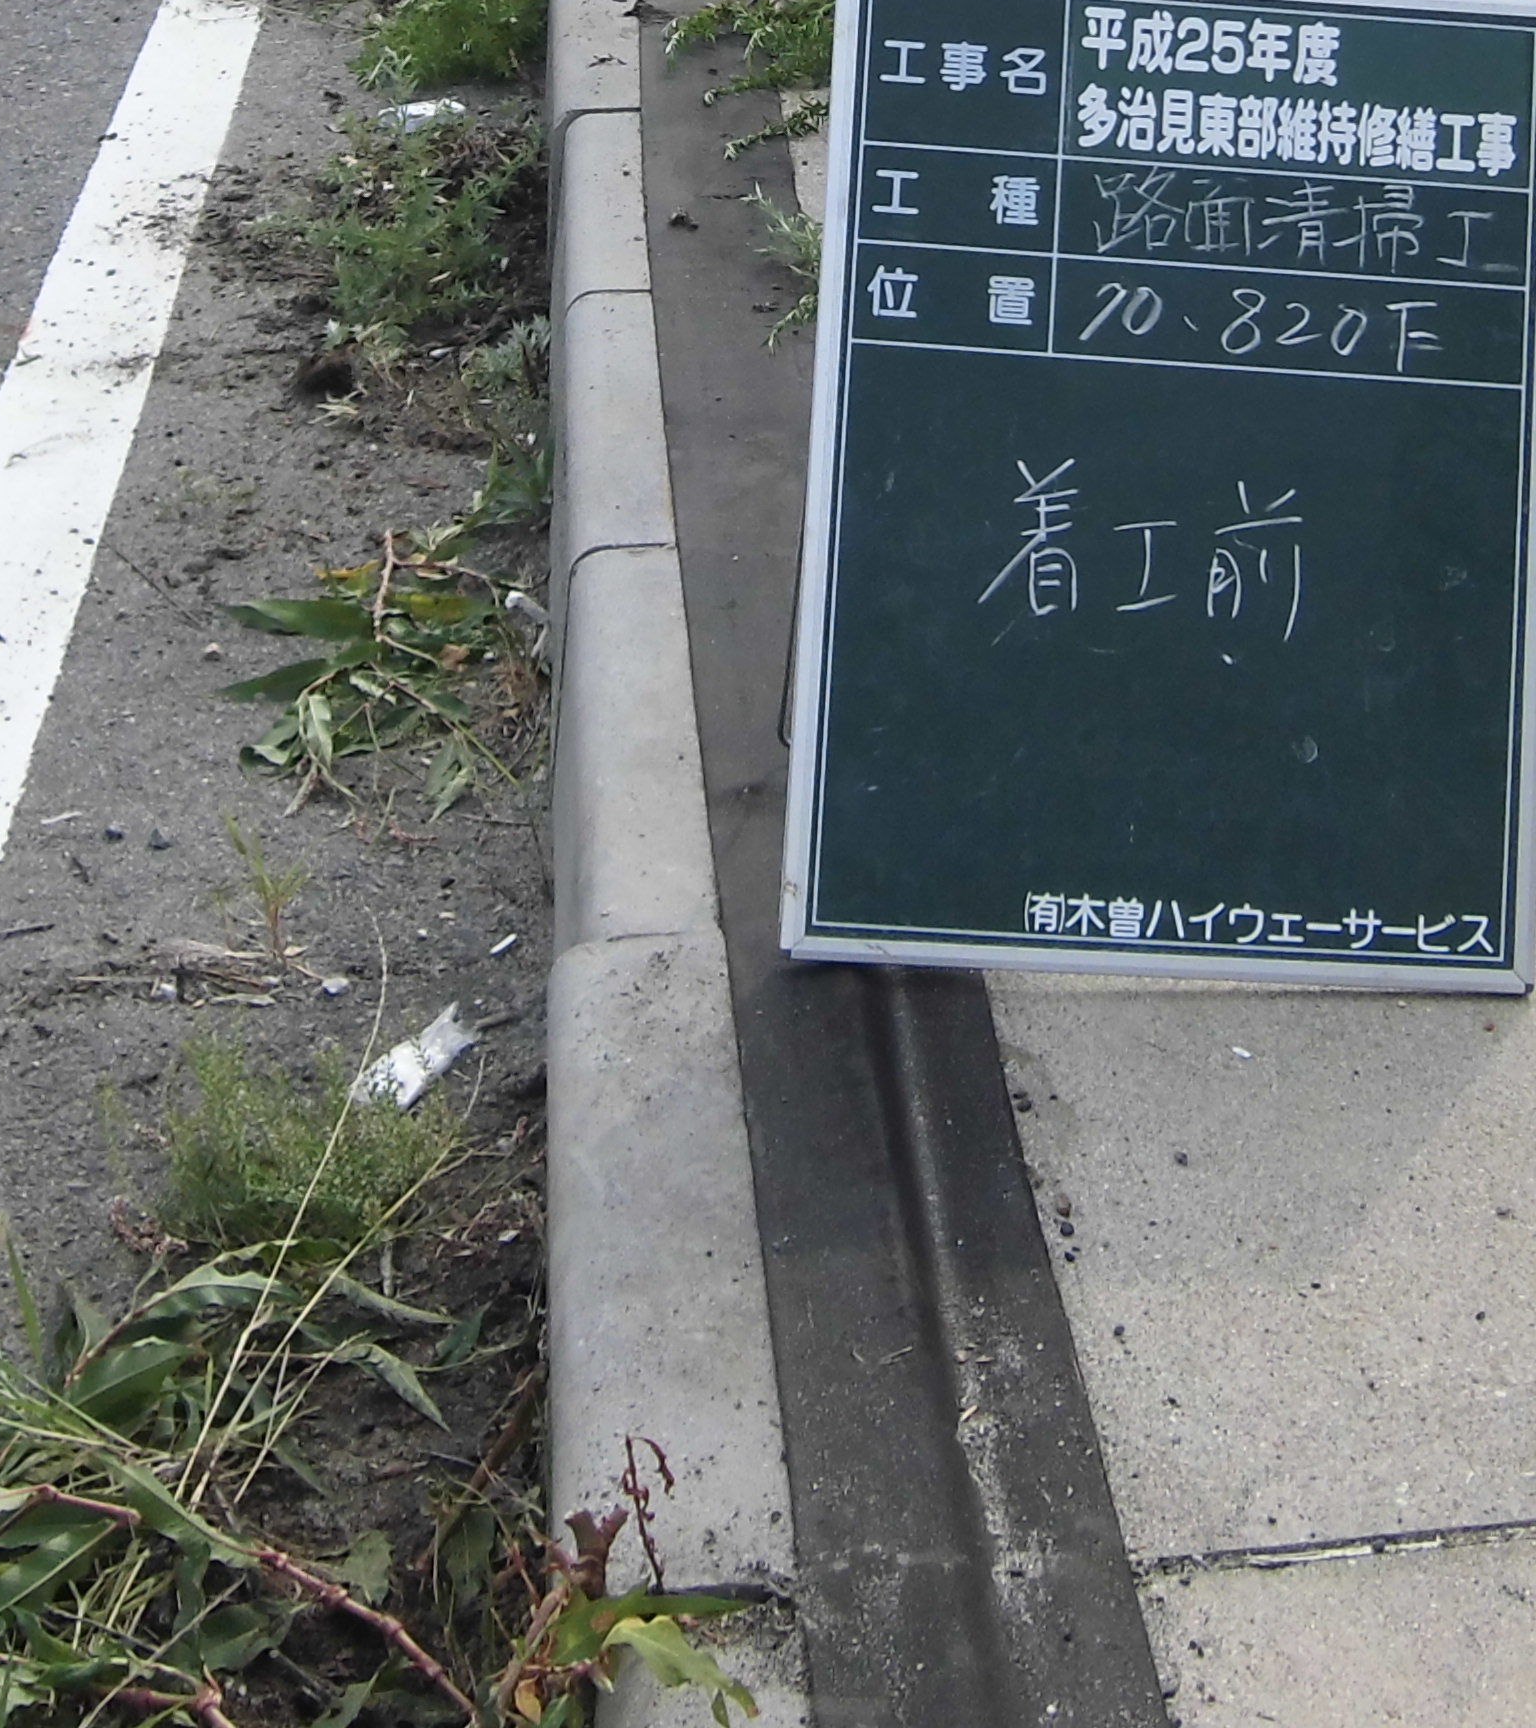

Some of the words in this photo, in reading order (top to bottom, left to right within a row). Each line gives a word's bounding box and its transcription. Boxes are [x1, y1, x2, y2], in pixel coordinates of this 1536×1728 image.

[880, 38, 1047, 96] 工事名
[1082, 6, 1341, 88] 平成25年度
[1077, 83, 1517, 177] 多治見東部維持修繕工事
[1094, 169, 1521, 275] 路面清掃工
[978, 459, 1304, 642] 着工前
